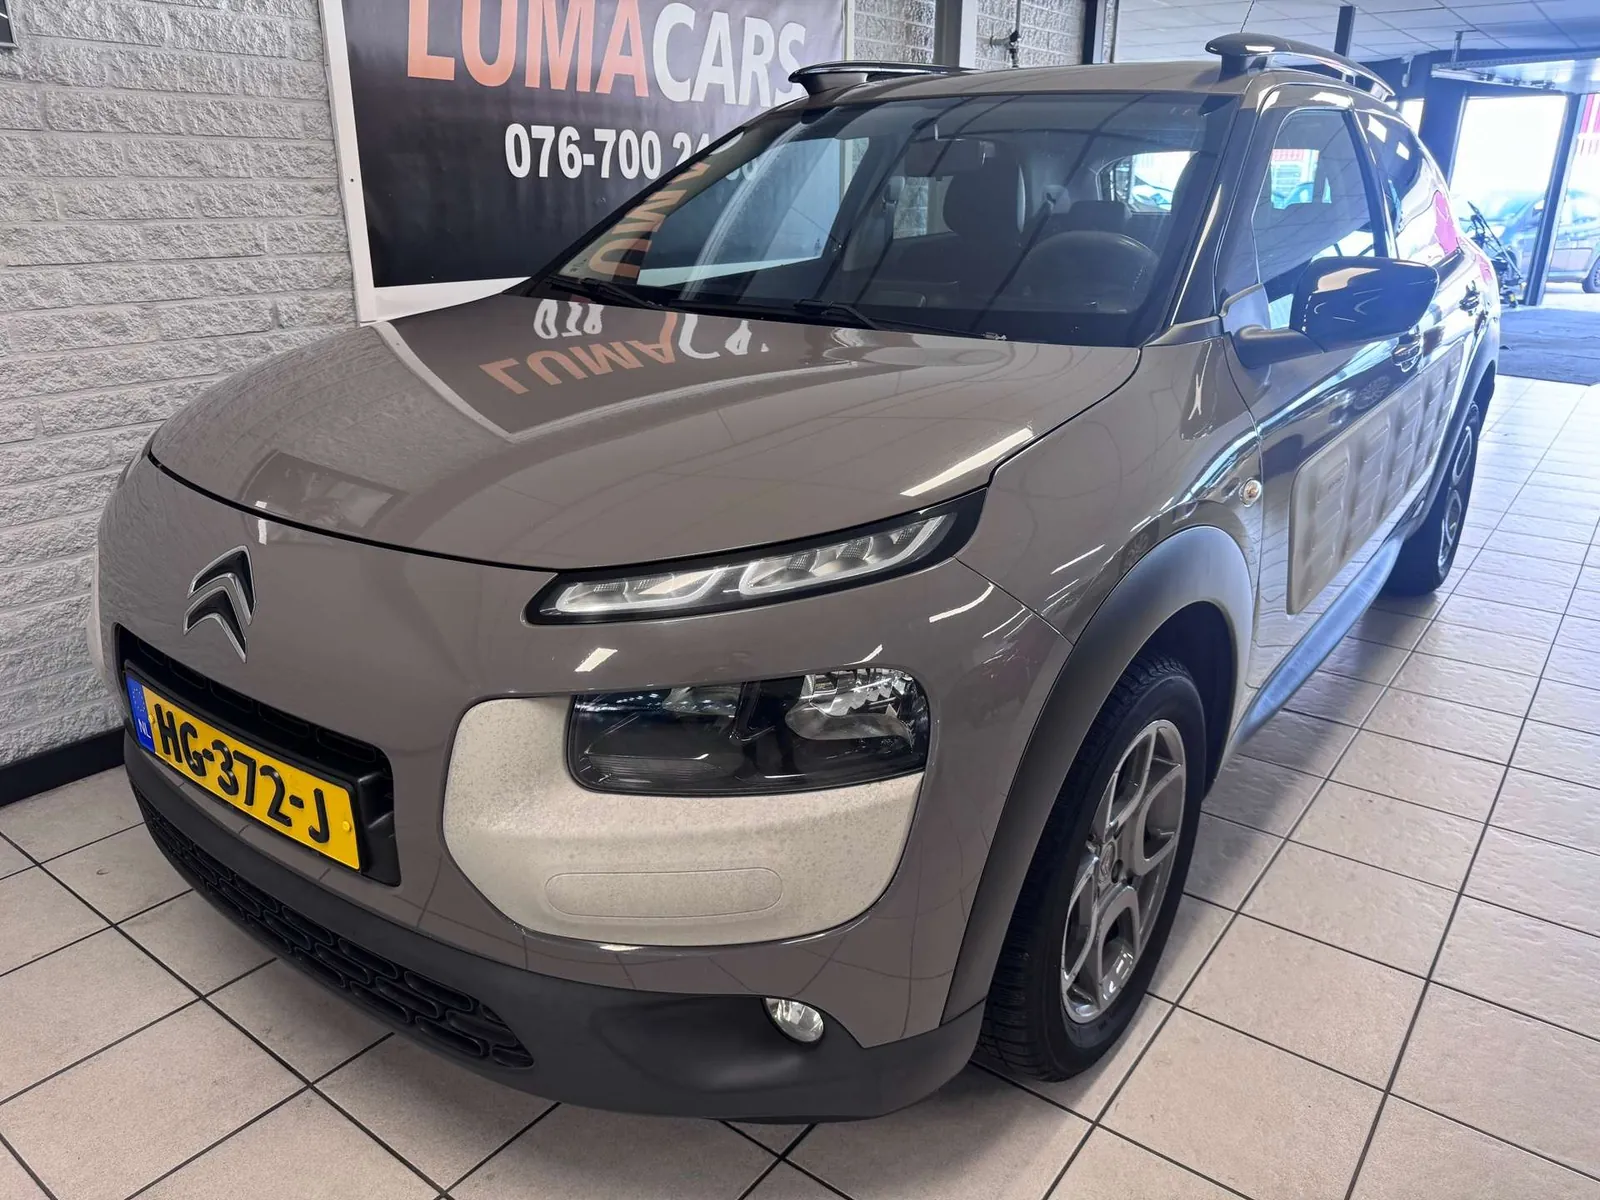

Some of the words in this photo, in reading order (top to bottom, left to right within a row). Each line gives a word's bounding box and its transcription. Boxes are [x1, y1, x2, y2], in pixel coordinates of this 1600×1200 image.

[504, 123, 661, 180] 076-700
[138, 719, 152, 739] NL
[154, 703, 330, 844] HG-372-J
